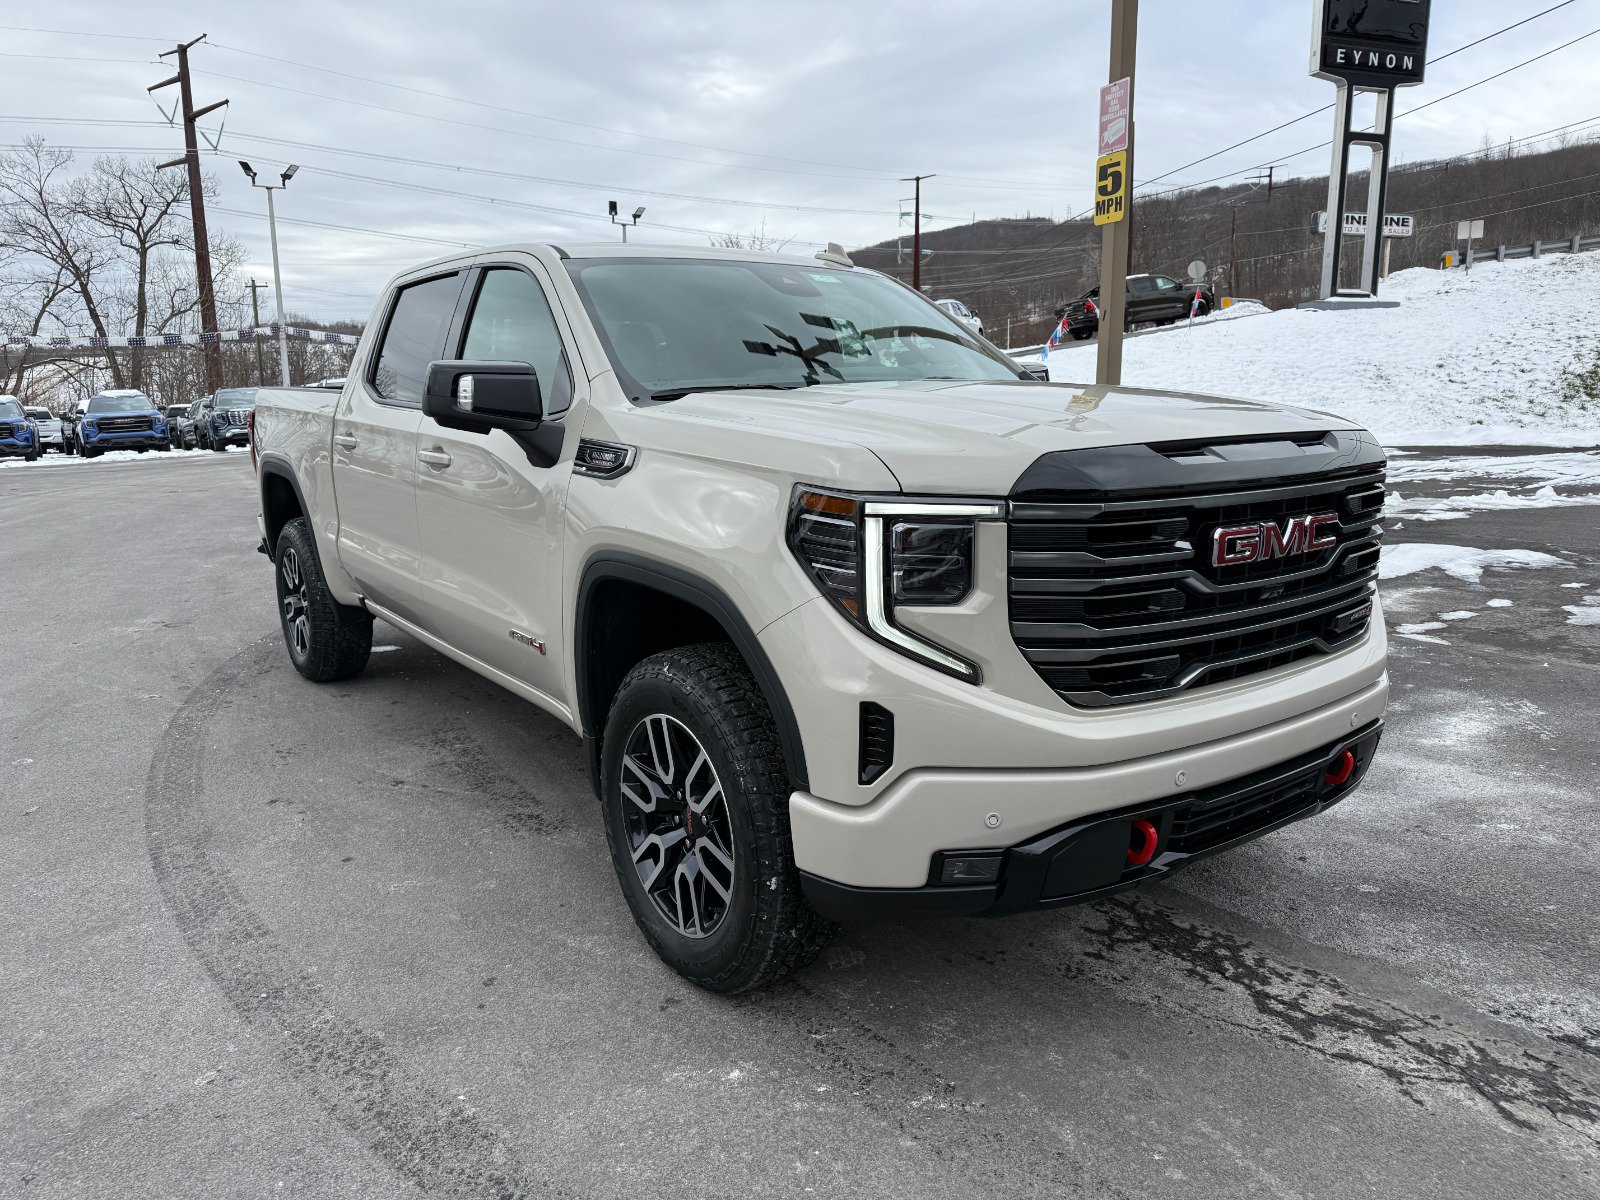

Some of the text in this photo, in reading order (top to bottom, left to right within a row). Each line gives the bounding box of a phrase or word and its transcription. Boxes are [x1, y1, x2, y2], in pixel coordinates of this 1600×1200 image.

[1336, 48, 1413, 70] EYNON
[1098, 161, 1122, 197] 5
[1095, 195, 1123, 217] MPH
[1212, 510, 1339, 568] GMC
